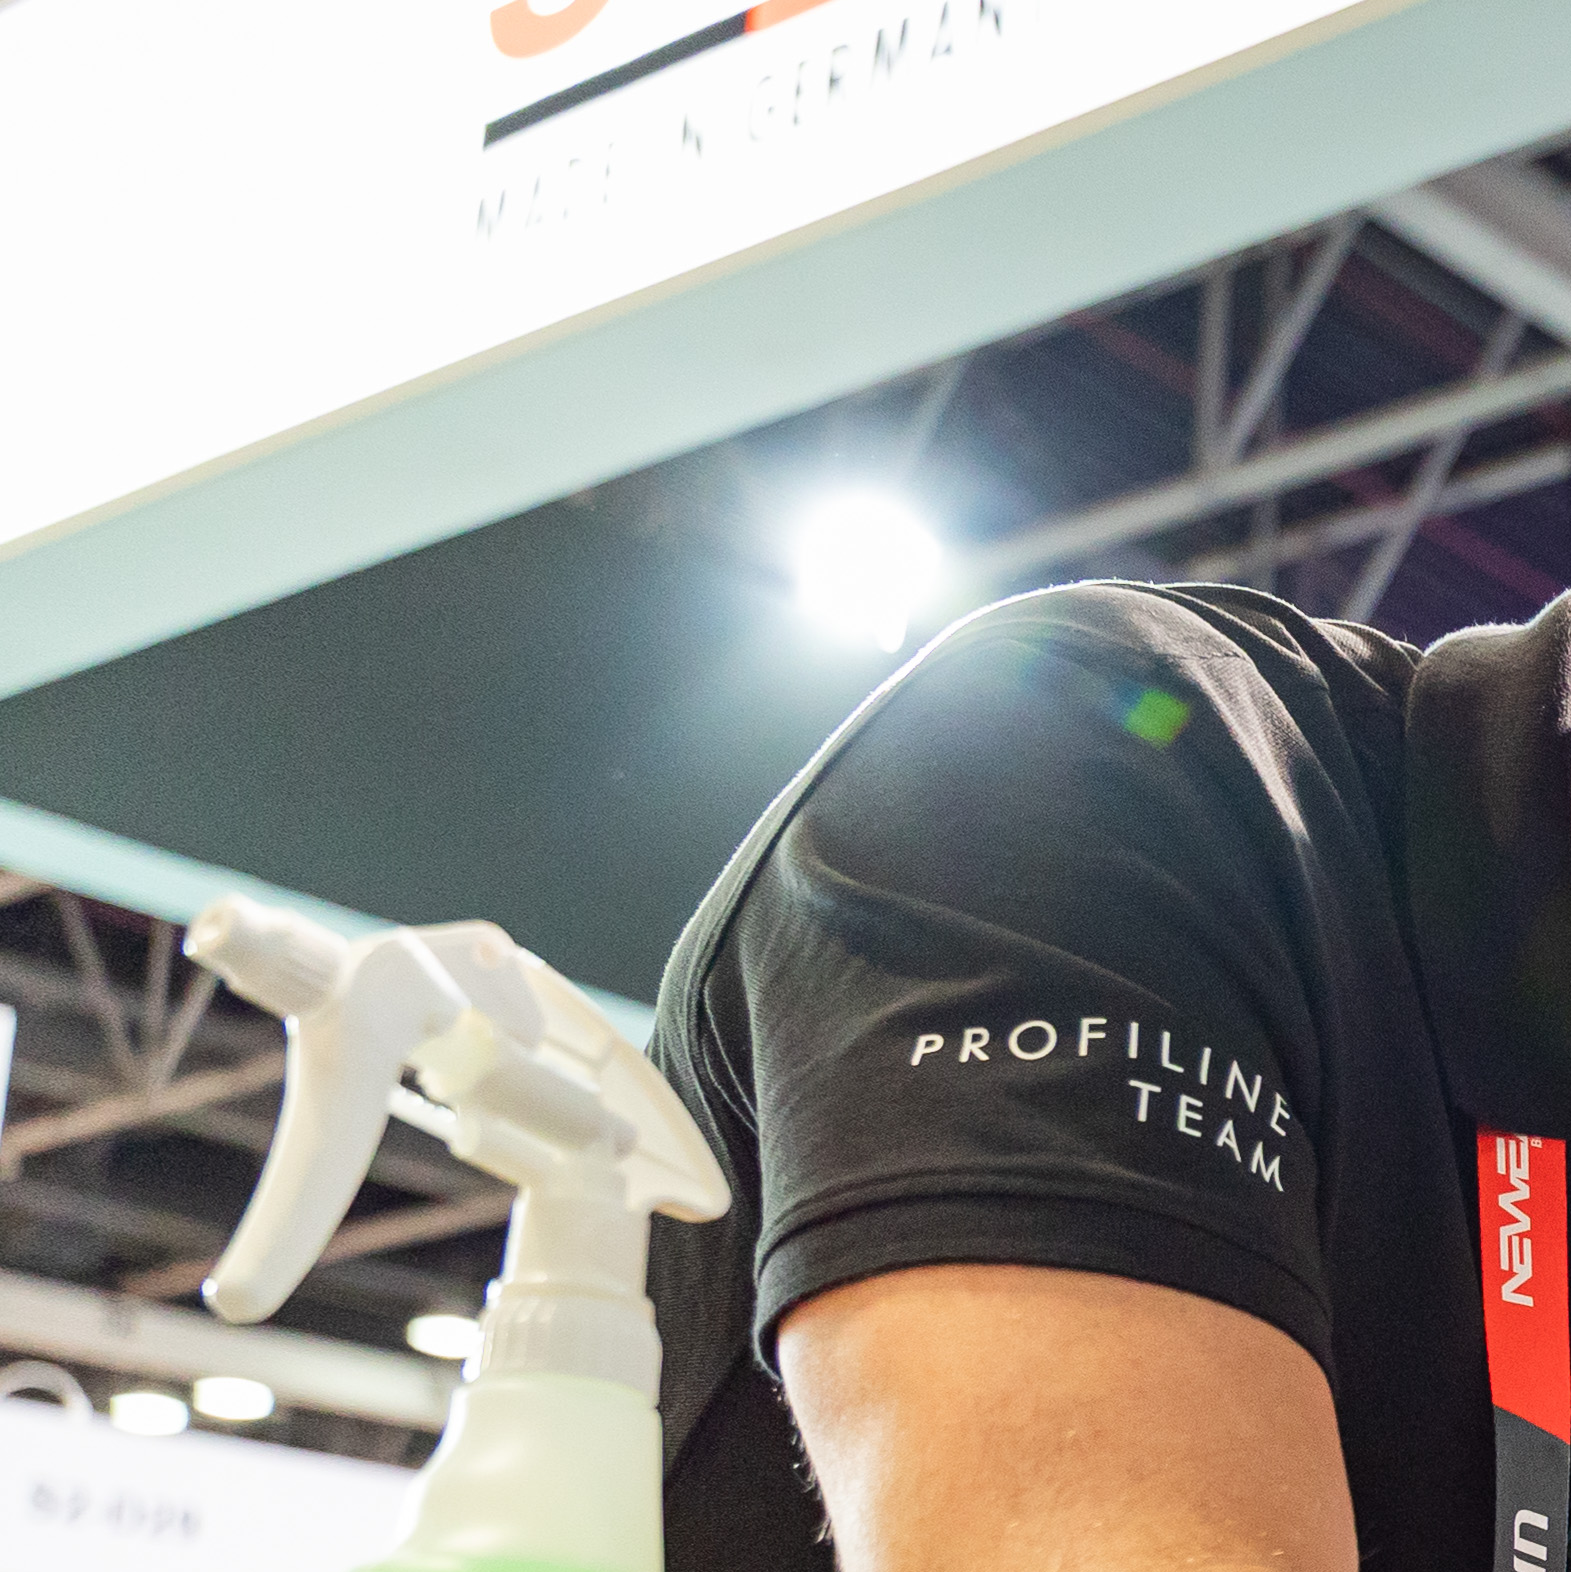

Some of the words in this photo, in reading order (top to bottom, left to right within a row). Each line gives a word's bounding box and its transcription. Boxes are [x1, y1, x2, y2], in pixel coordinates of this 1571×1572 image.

[748, 0, 1041, 143] GERMAN
[911, 1017, 1291, 1136] PROFILINE
[1128, 1079, 1284, 1192] TEAM
[1496, 1135, 1535, 1307] NEWE
